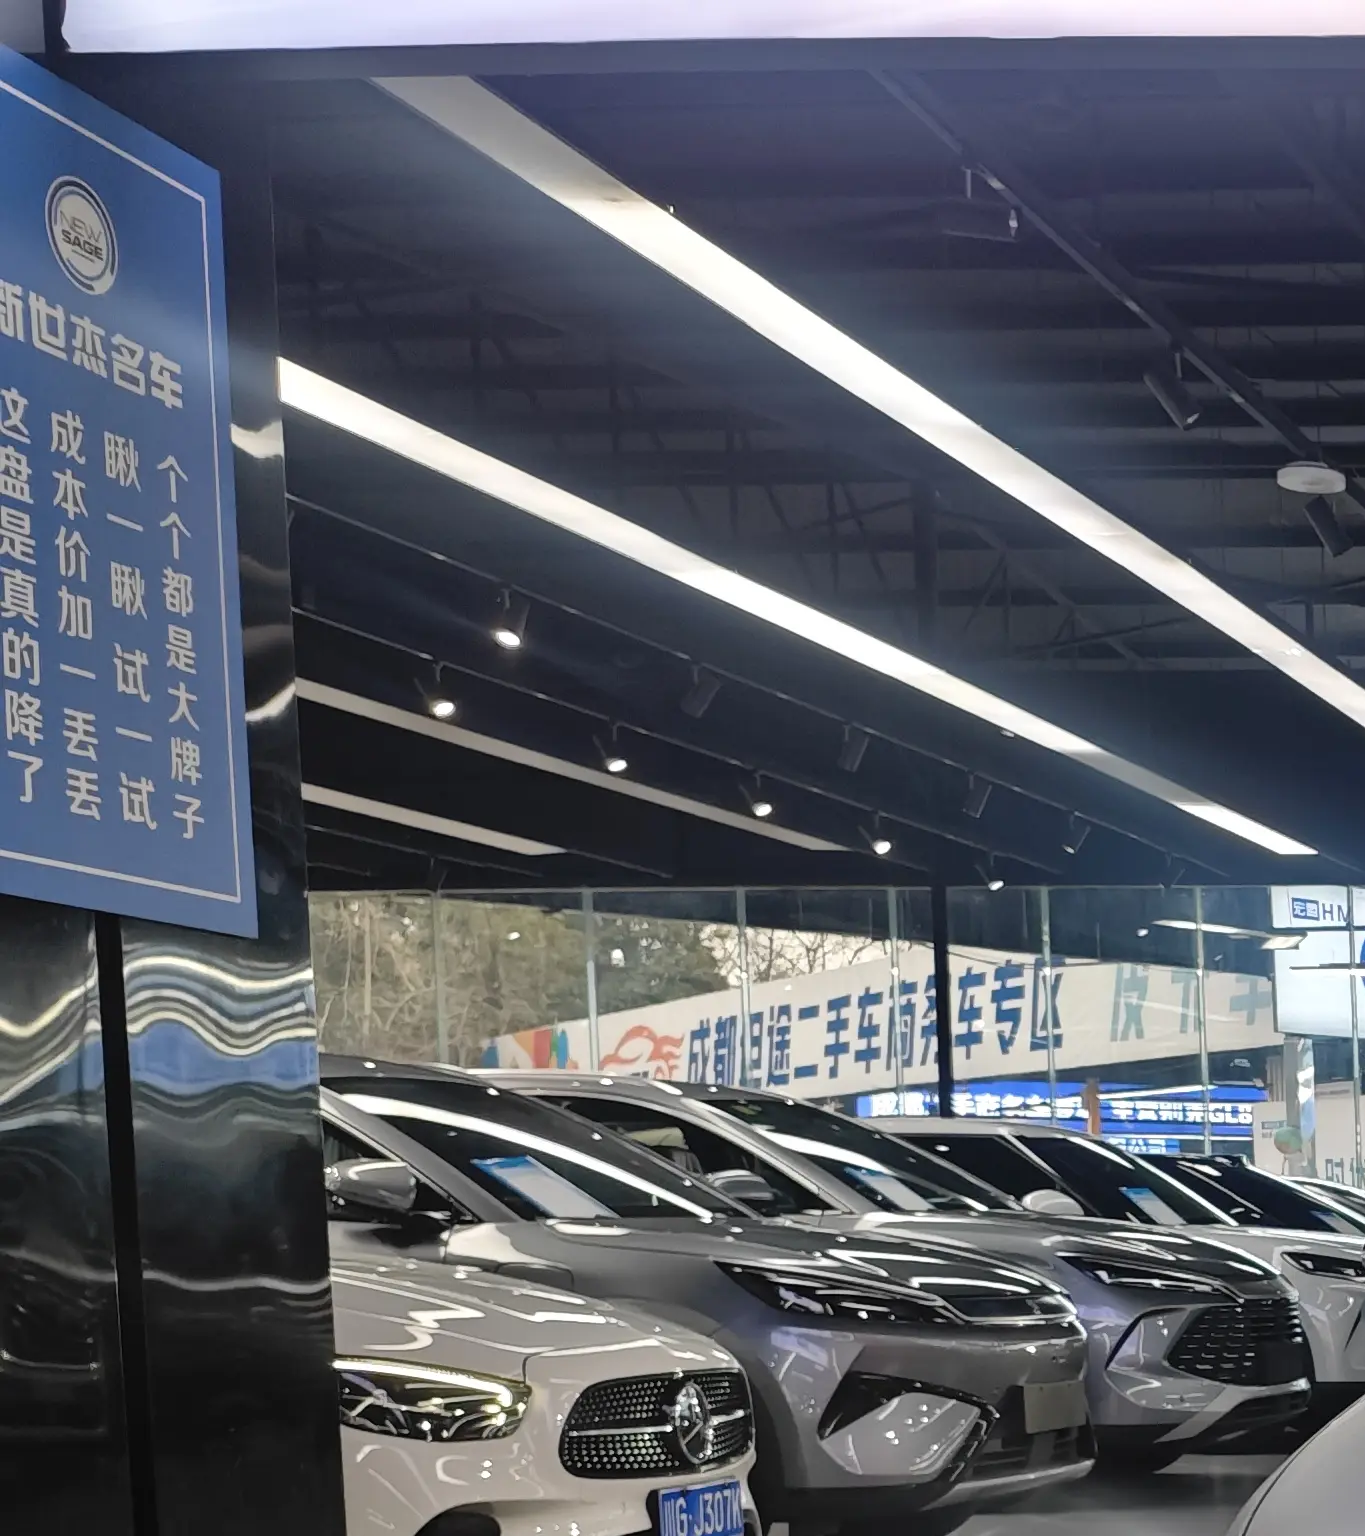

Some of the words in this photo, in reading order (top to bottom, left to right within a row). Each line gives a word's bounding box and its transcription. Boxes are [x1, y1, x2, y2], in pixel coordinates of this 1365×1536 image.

[59, 210, 102, 243] NEW
[62, 229, 104, 262] SAGE
[50, 410, 102, 821] 成本价加一丢丢
[157, 455, 204, 839] 个个都是大牌子
